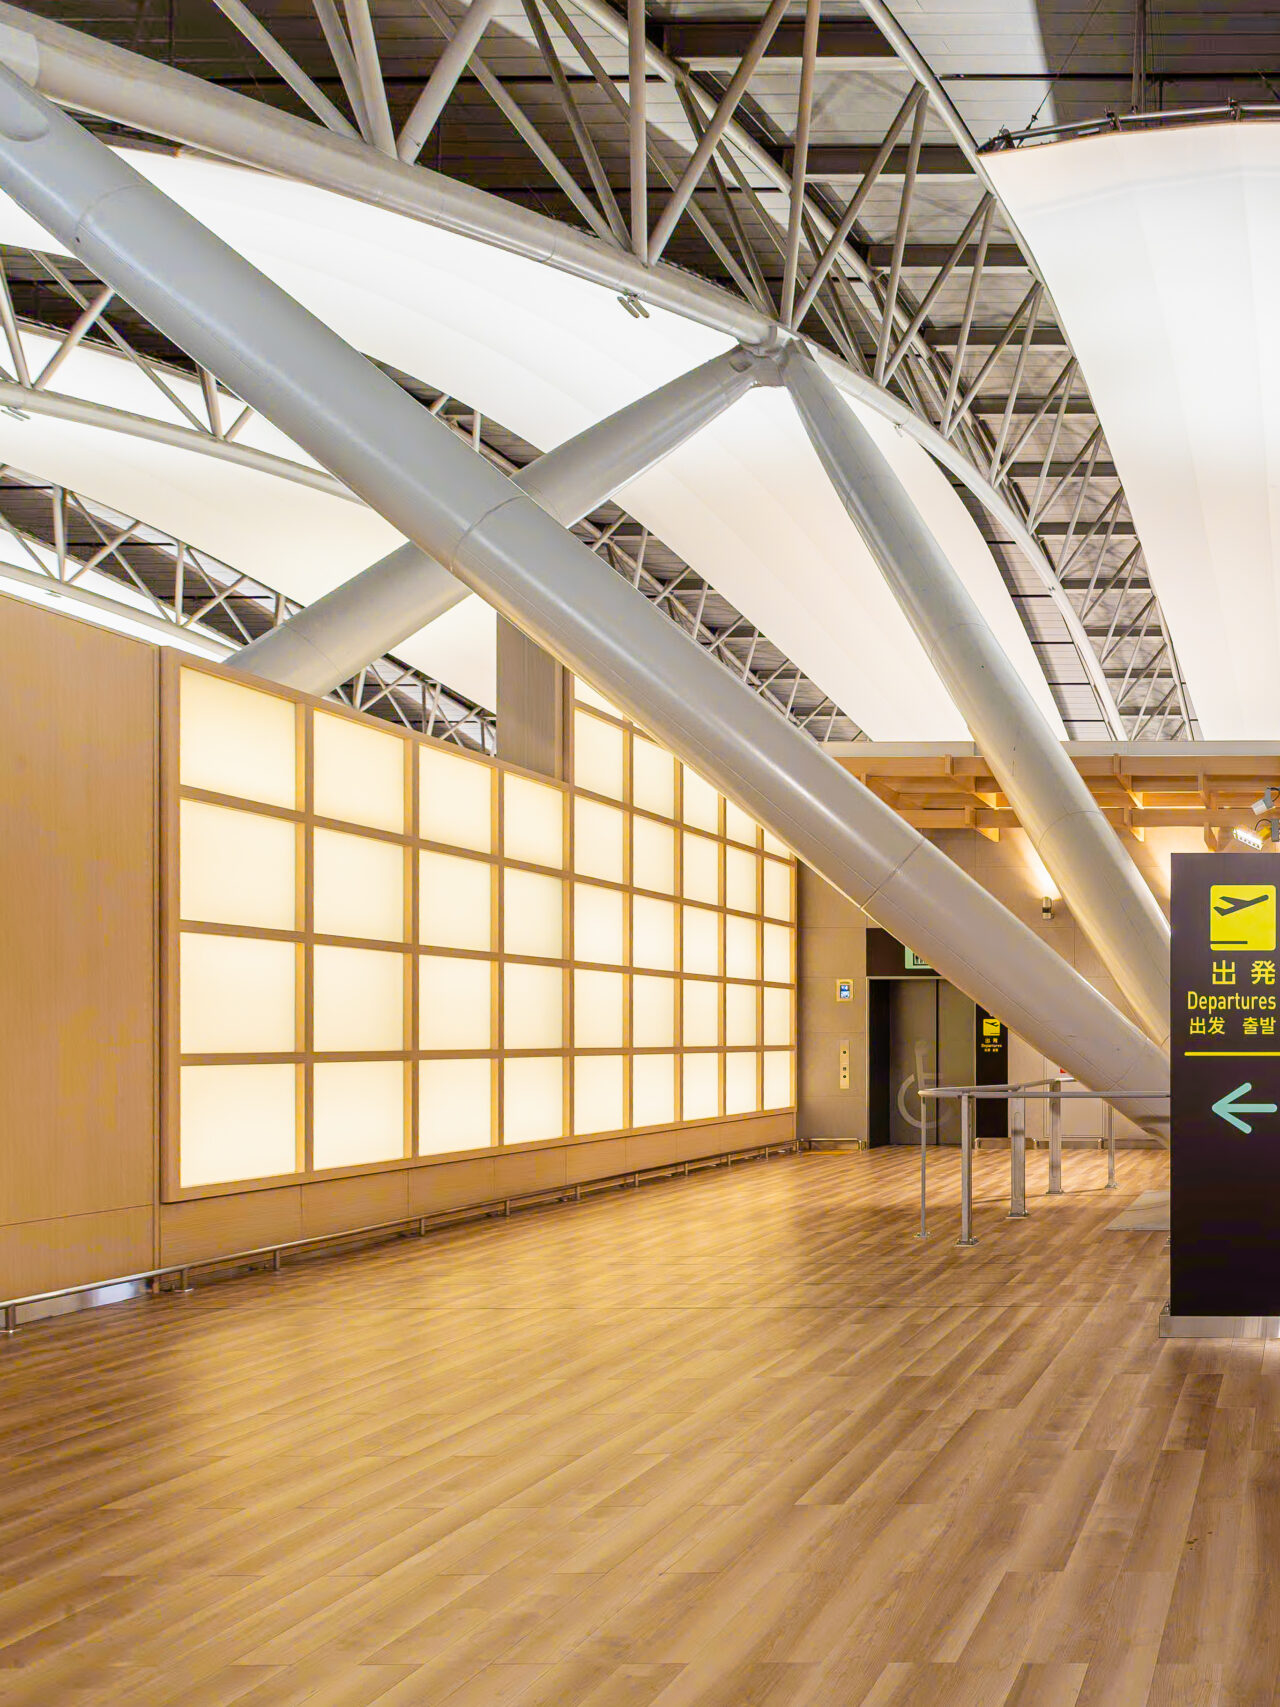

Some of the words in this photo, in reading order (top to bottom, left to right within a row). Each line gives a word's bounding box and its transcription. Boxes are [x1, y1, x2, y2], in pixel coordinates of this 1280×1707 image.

[1187, 991, 1276, 1014] Departures
[1189, 1017, 1226, 1035] 出发
[1242, 1017, 1276, 1035] 출발
